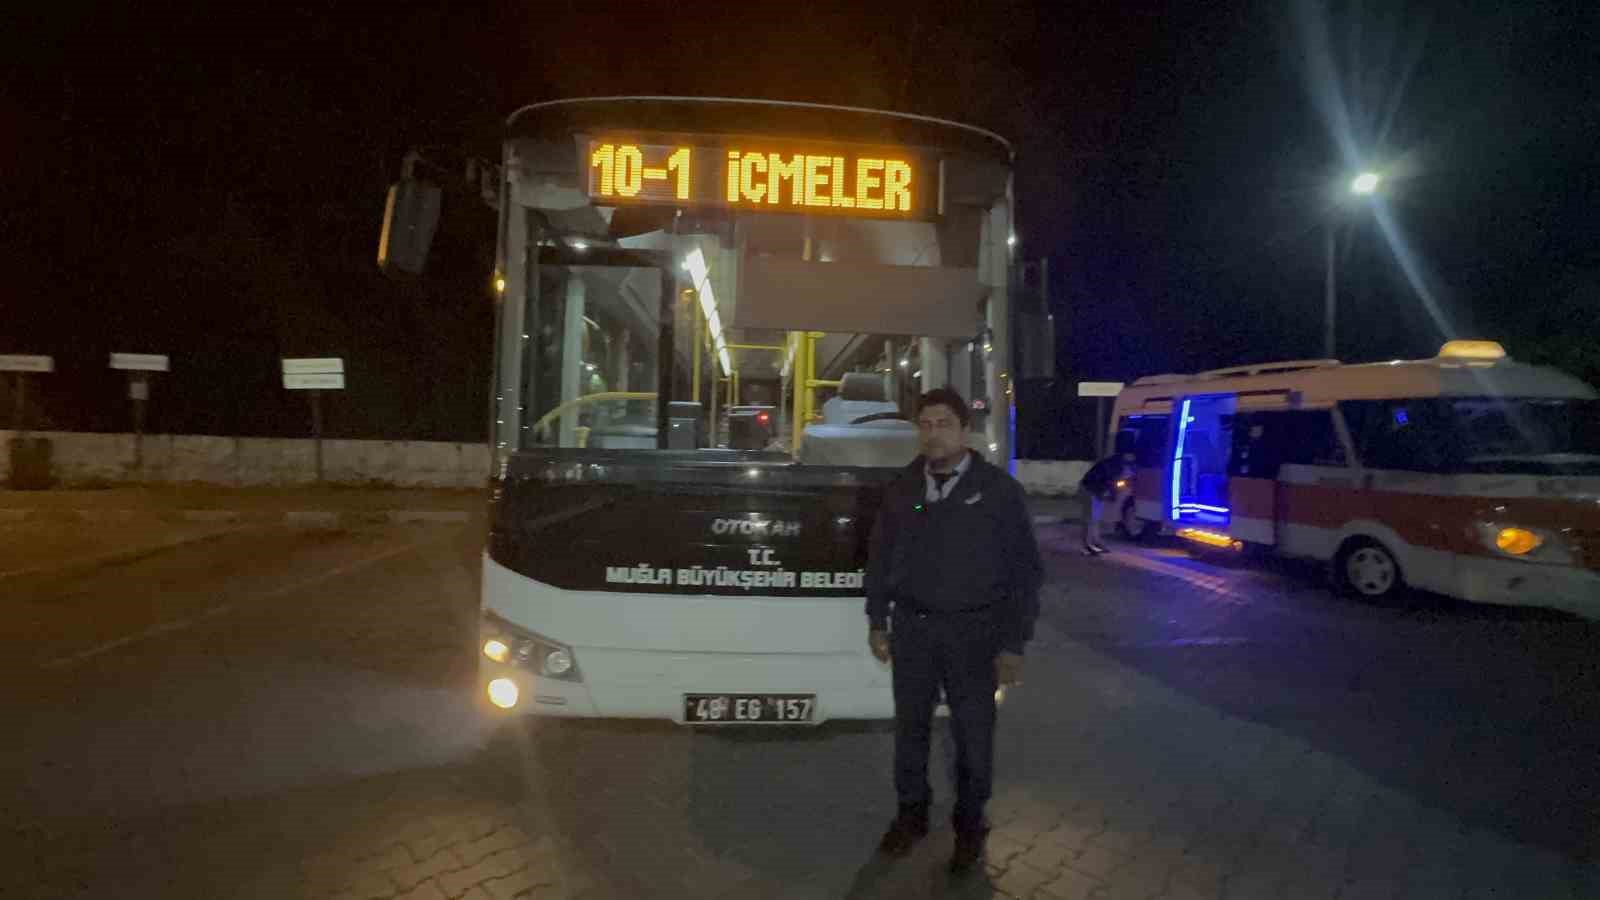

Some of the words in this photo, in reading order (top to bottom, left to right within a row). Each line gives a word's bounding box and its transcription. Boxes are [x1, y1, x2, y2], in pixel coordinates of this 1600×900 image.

[592, 144, 691, 199] 10-1
[606, 563, 673, 585] MUĞLA
[676, 565, 797, 590] BÜYÜKŞEHİR
[800, 568, 865, 589] BELEDİ
[696, 699, 722, 720] 48
[776, 698, 810, 720] 157
